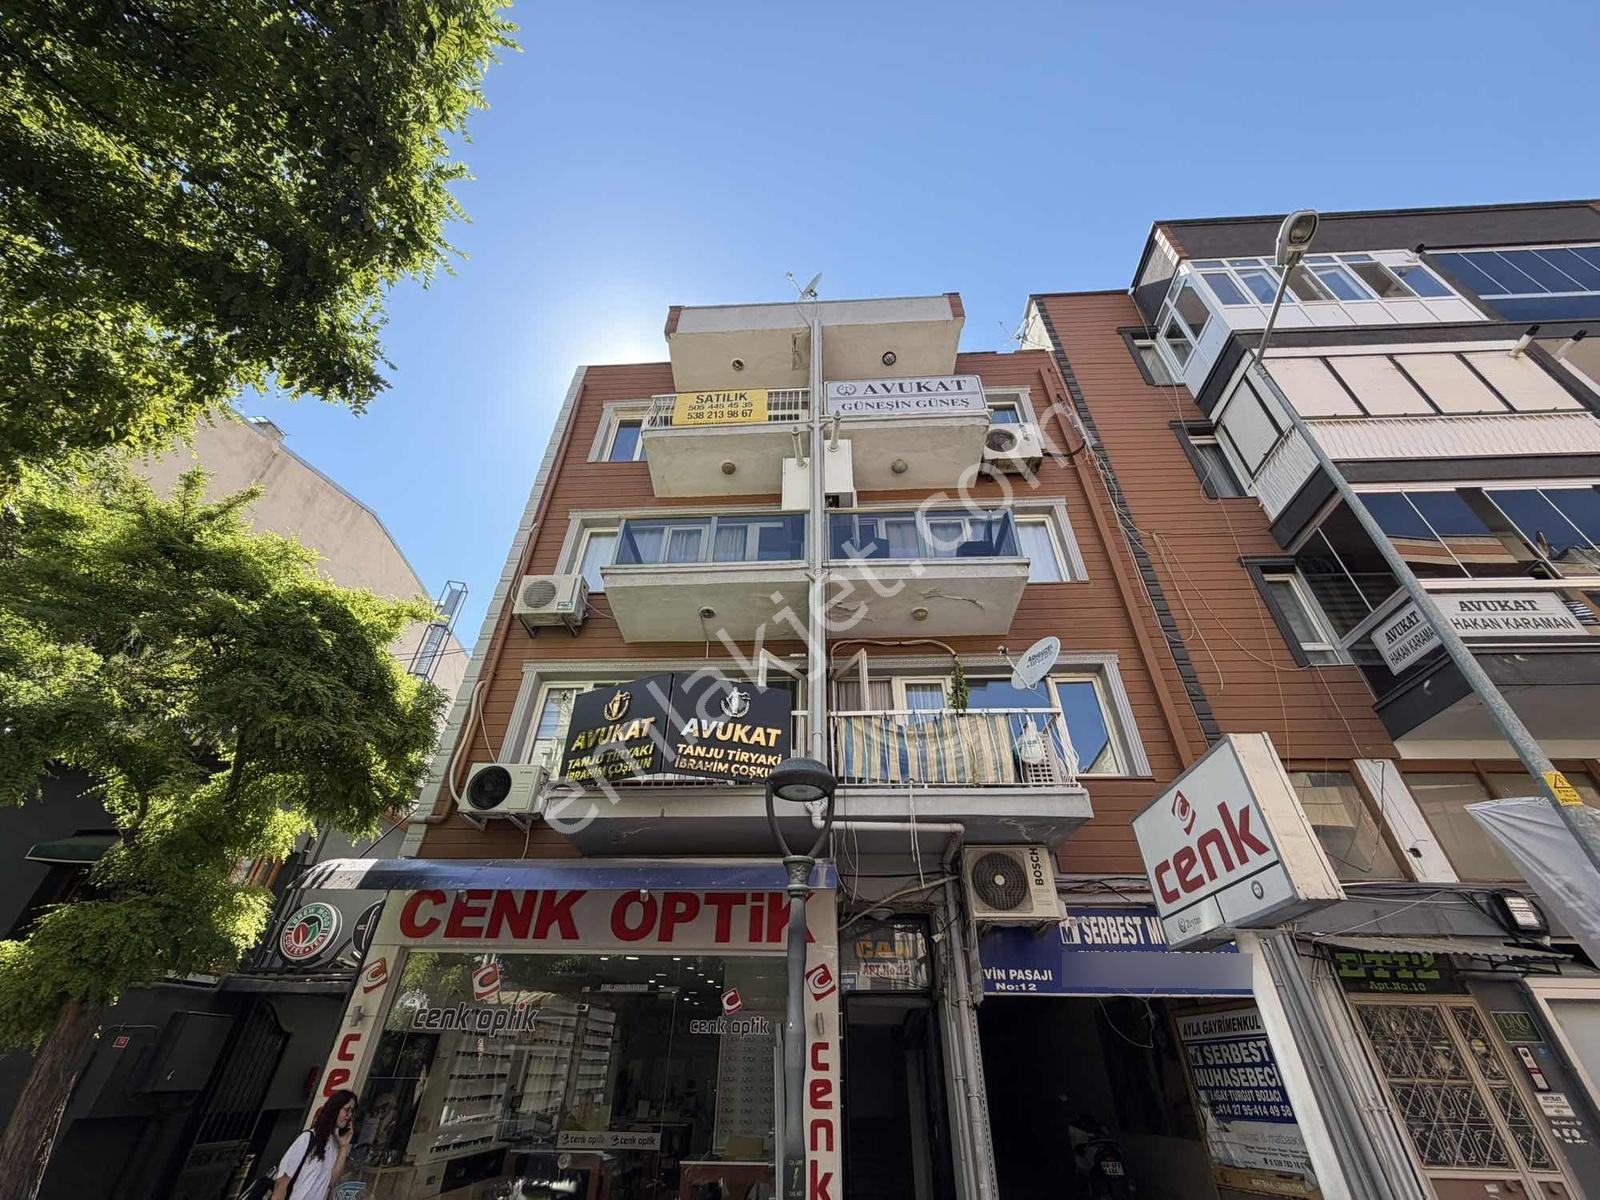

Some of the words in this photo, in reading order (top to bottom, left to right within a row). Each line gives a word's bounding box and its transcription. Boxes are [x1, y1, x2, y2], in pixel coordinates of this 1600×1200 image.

[696, 392, 747, 404] SATILIK
[863, 379, 966, 395] AVUKAT
[687, 411, 704, 420] 538
[707, 410, 724, 419] 213
[727, 409, 739, 418] 98
[742, 408, 753, 418] 67
[916, 398, 970, 408] GÜNEŞ
[1458, 599, 1540, 612] AVUKAT
[1384, 611, 1421, 644] AVUKAT
[1450, 617, 1502, 629] HAKAN
[1504, 616, 1576, 629] KARAMAN
[1388, 643, 1413, 665] HAKAN
[1408, 625, 1438, 653] KARAMA
[571, 719, 655, 752] AVUKAT
[681, 718, 781, 747] AVUKAT
[677, 744, 724, 759] TANJU
[727, 749, 782, 766] TİRYAKİ
[675, 755, 729, 773] İBRAHİM
[731, 764, 775, 779] ÇOŞKU
[1155, 801, 1271, 904] cenk
[1029, 848, 1044, 885] BOSCH
[400, 889, 588, 940] CENK
[1080, 916, 1144, 945] SERBEST
[995, 982, 1037, 991] No:12
[1009, 969, 1053, 981] PASAJI
[412, 1002, 470, 1030] cenk
[475, 1002, 537, 1037] optik
[689, 1016, 726, 1034] cenk
[730, 1016, 770, 1038] optik
[1183, 1023, 1201, 1036] AYLA
[1202, 1014, 1261, 1034] GAYRİMENKUL
[1203, 1041, 1270, 1065] SERBEST
[1194, 1063, 1282, 1087] MUHASEBECİ
[1232, 1104, 1241, 1115] 27
[1269, 1105, 1280, 1117] 49
[1281, 1105, 1293, 1117] 58
